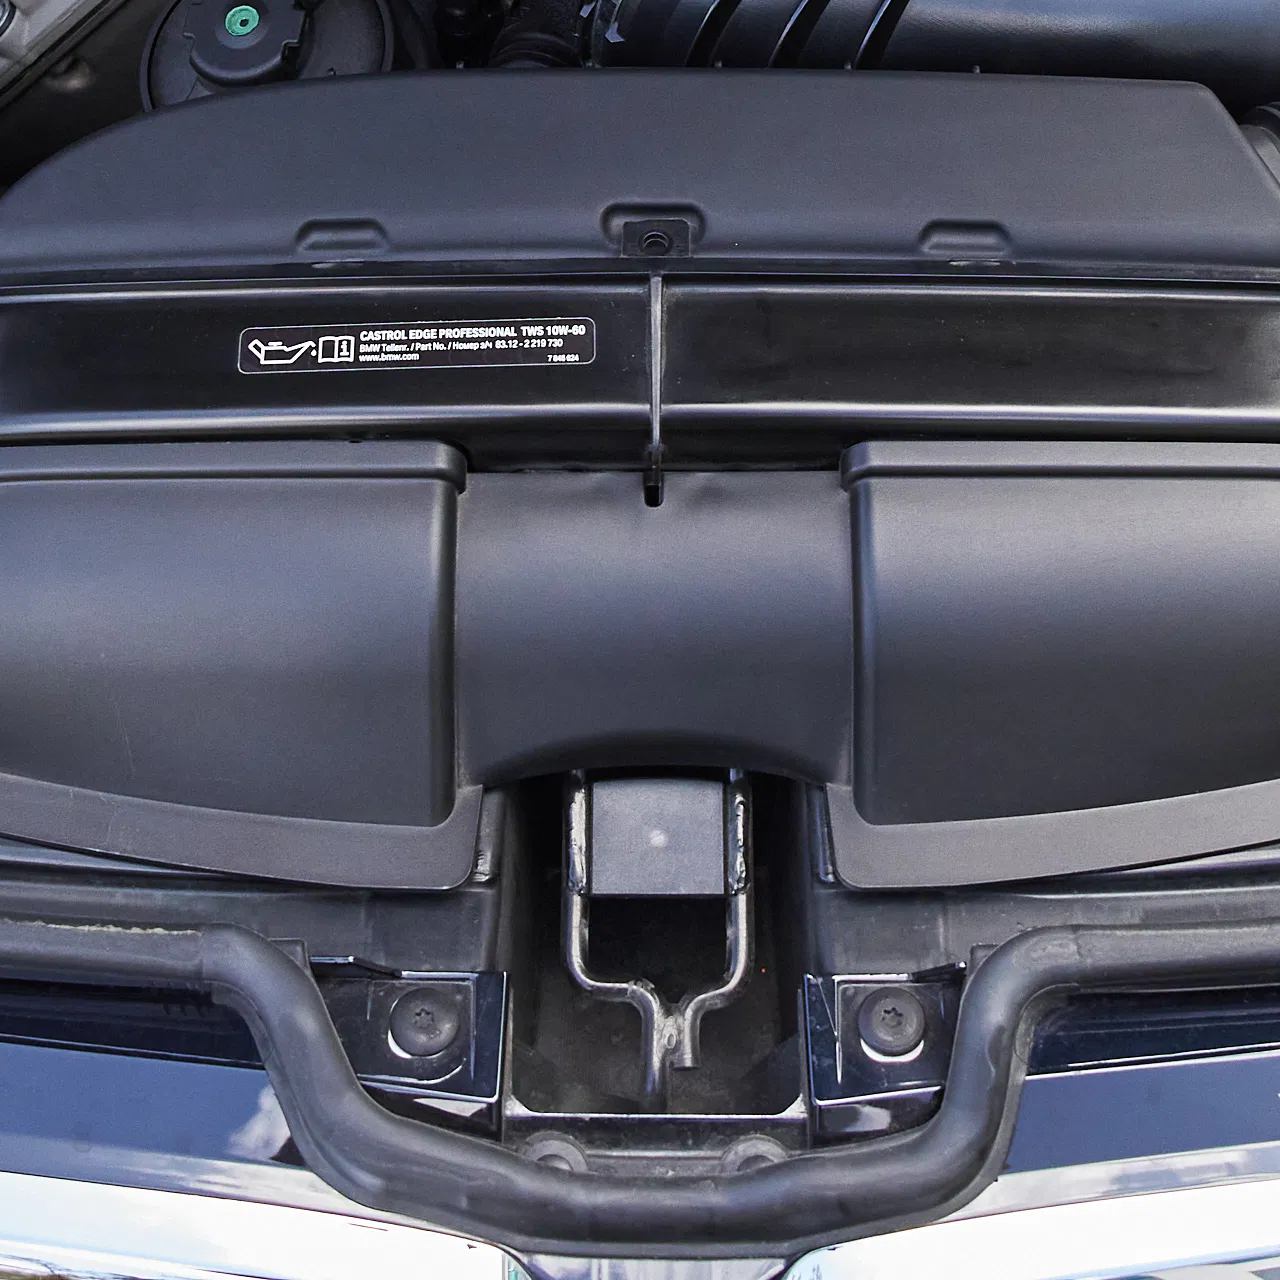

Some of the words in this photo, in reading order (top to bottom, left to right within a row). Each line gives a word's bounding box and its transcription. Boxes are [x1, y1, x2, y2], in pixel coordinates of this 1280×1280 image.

[360, 330, 408, 341] CASTROL
[409, 329, 438, 340] EDGE
[438, 326, 518, 339] PROFESSIONAL
[520, 325, 545, 337] TWS
[546, 324, 586, 336] 10W-60
[359, 344, 381, 352] BMW
[416, 342, 432, 351] Part
[433, 342, 447, 350] No.
[547, 338, 564, 347] 730
[358, 353, 420, 362] www.bmw.com
